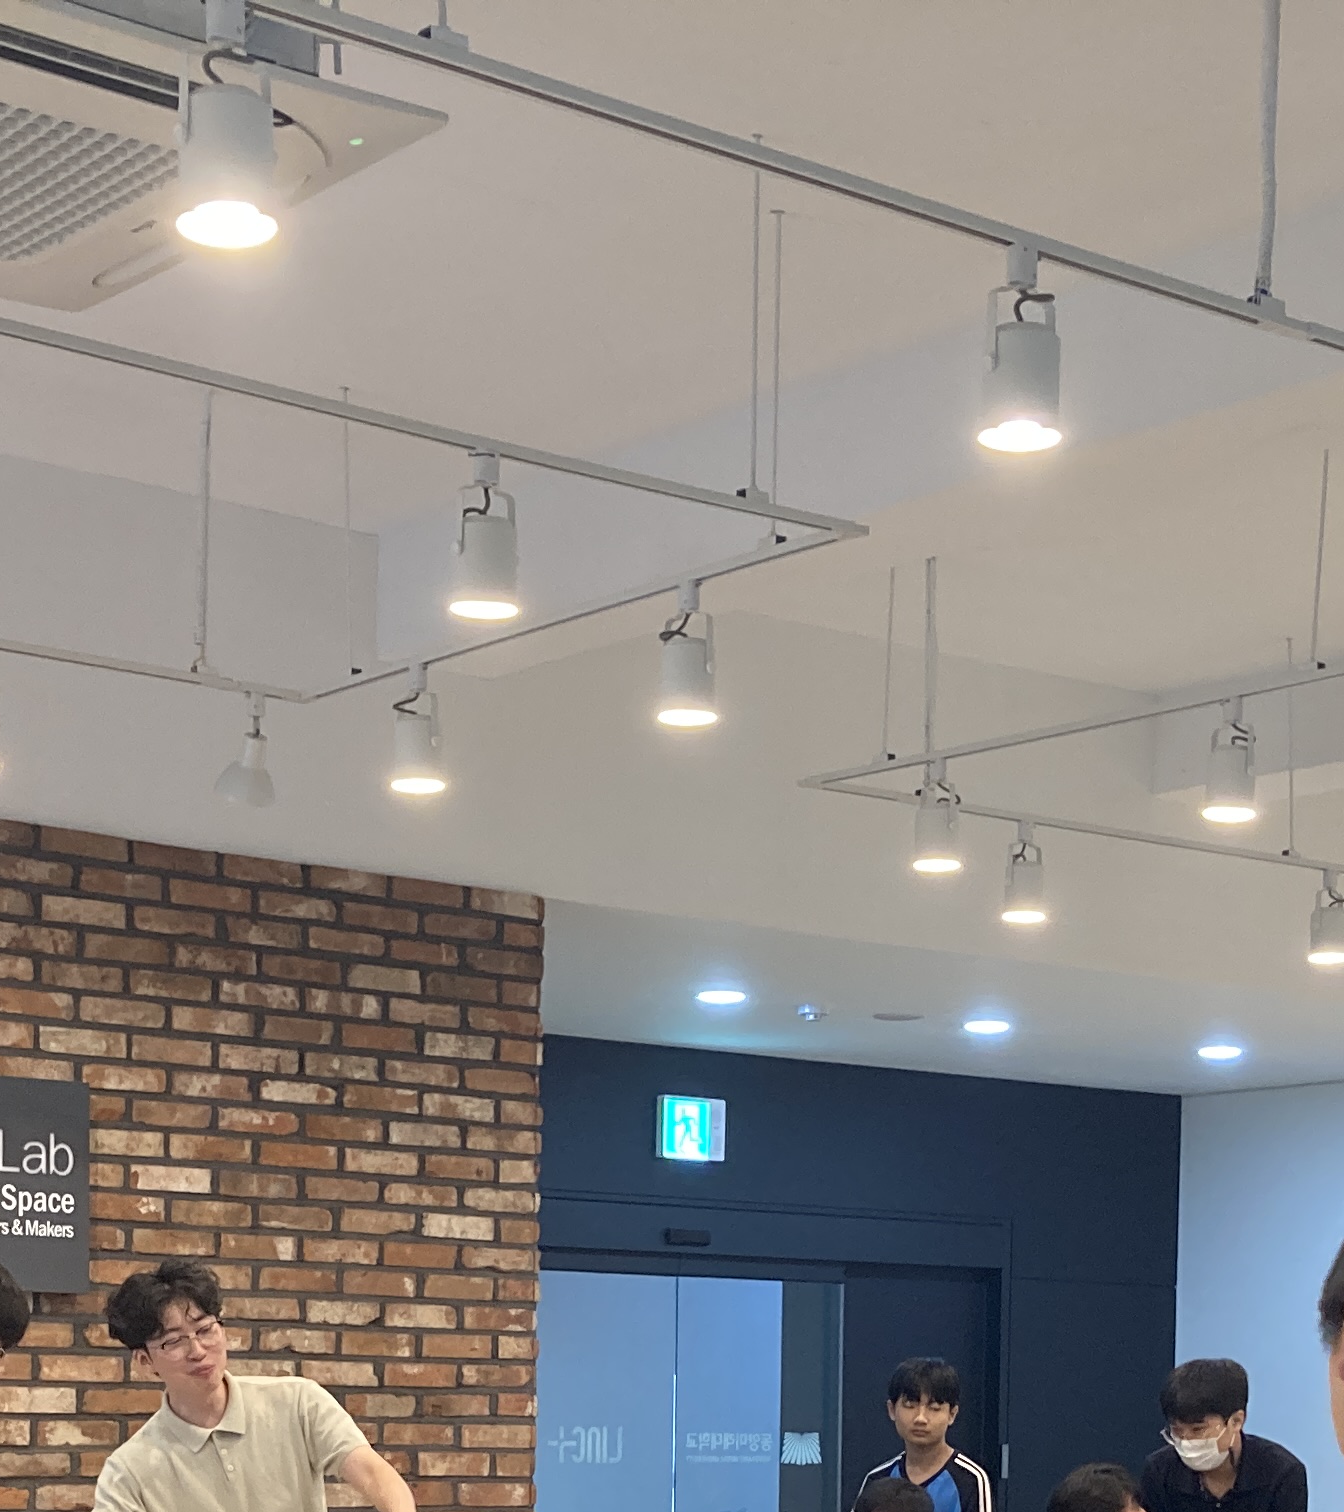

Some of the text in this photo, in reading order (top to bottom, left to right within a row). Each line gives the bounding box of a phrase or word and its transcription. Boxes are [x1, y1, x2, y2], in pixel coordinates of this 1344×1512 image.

[1, 1184, 76, 1216] Space
[11, 1219, 24, 1236] &
[25, 1220, 75, 1239] Makers
